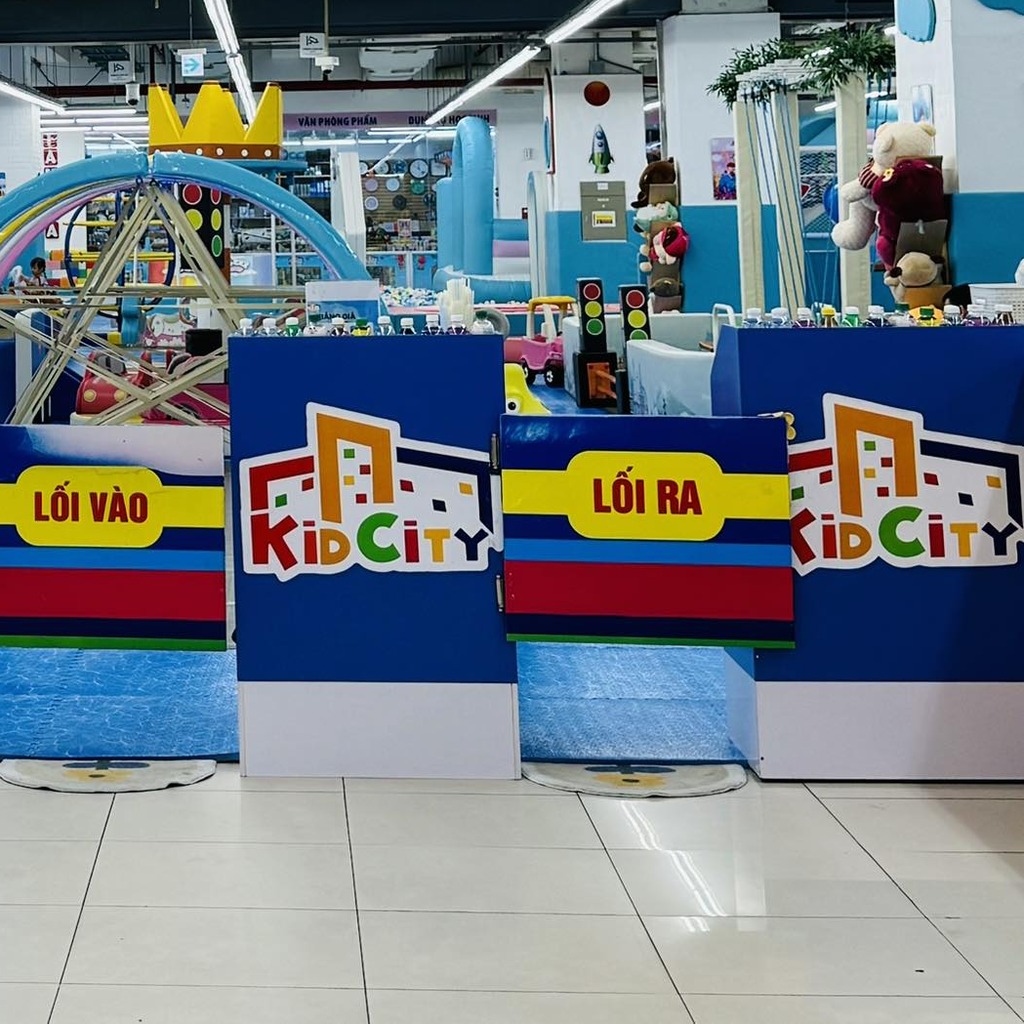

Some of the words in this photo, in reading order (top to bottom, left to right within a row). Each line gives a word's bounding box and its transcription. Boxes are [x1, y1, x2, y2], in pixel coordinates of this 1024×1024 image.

[34, 480, 80, 522] LỐI
[89, 485, 148, 523] VÀO
[593, 466, 646, 514] LỐI
[657, 479, 703, 515] RA
